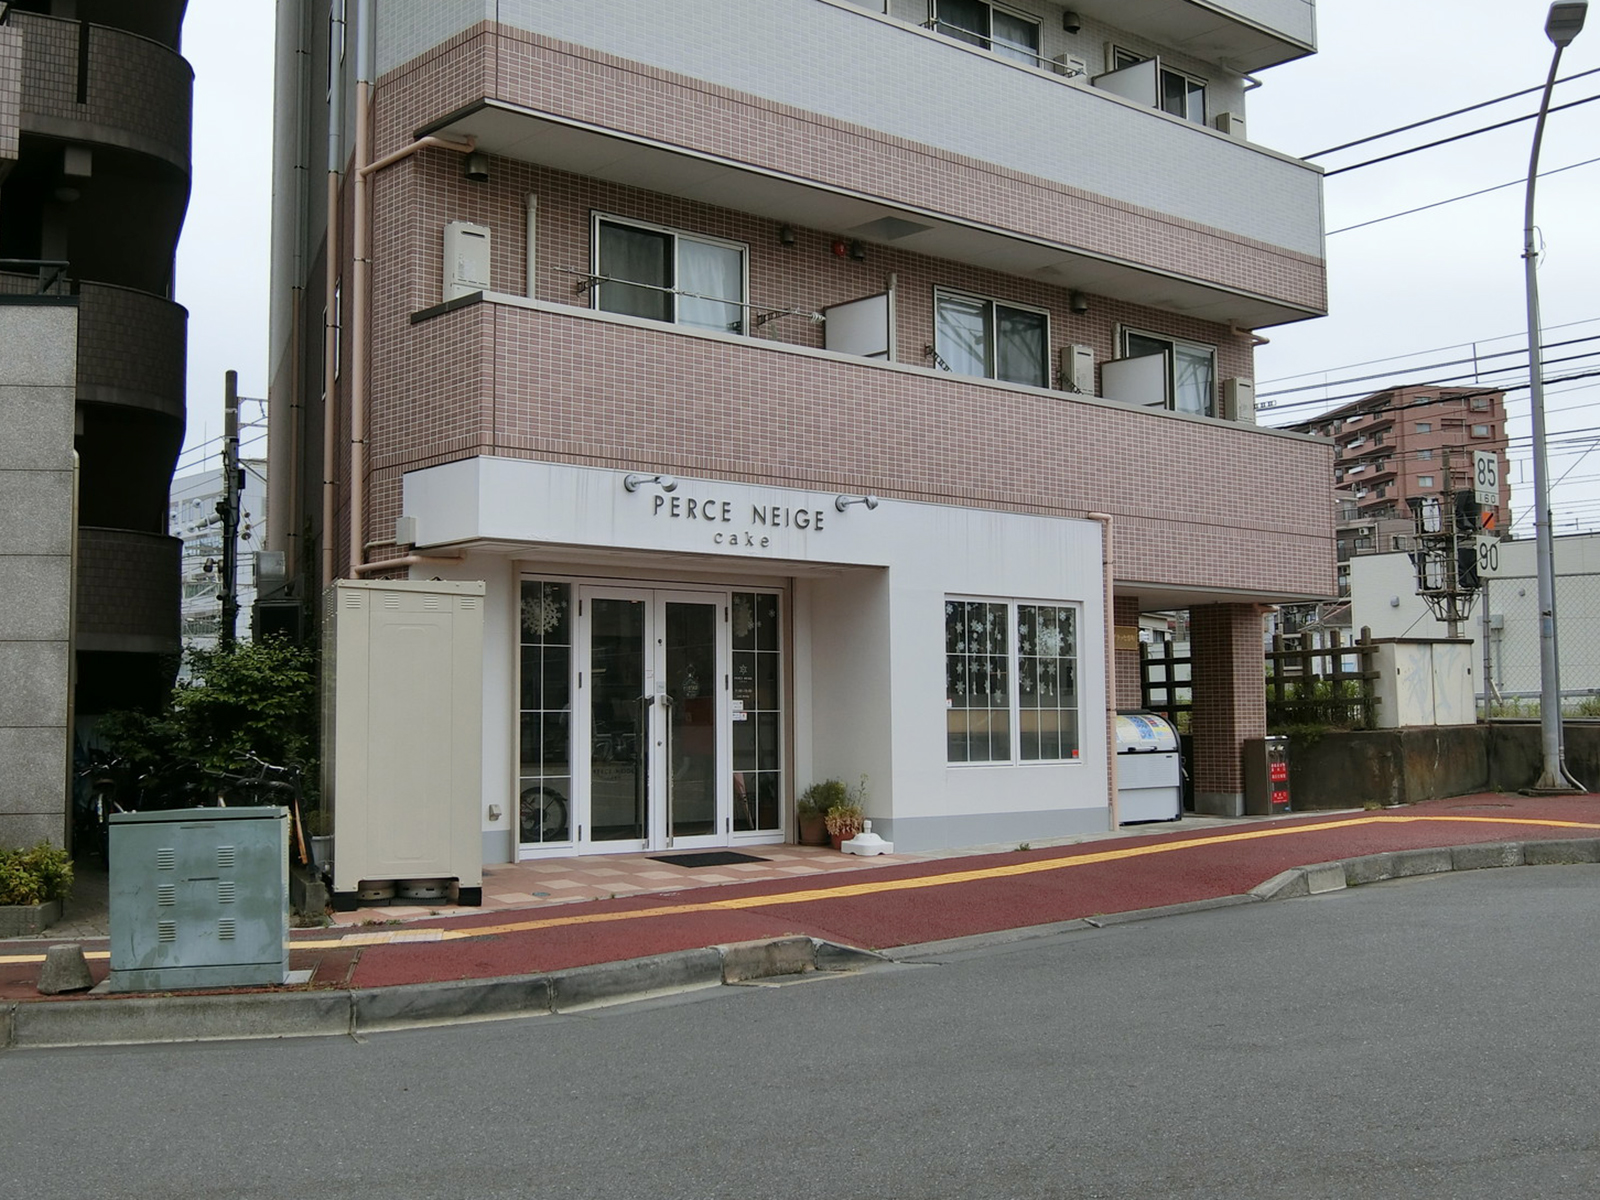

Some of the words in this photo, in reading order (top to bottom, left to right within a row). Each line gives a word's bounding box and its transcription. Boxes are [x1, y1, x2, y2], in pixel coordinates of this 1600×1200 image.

[1477, 457, 1496, 487] 85
[653, 495, 732, 522] PERCE
[752, 504, 825, 531] NEIGE
[713, 531, 770, 548] cake
[1479, 542, 1499, 571] 90
